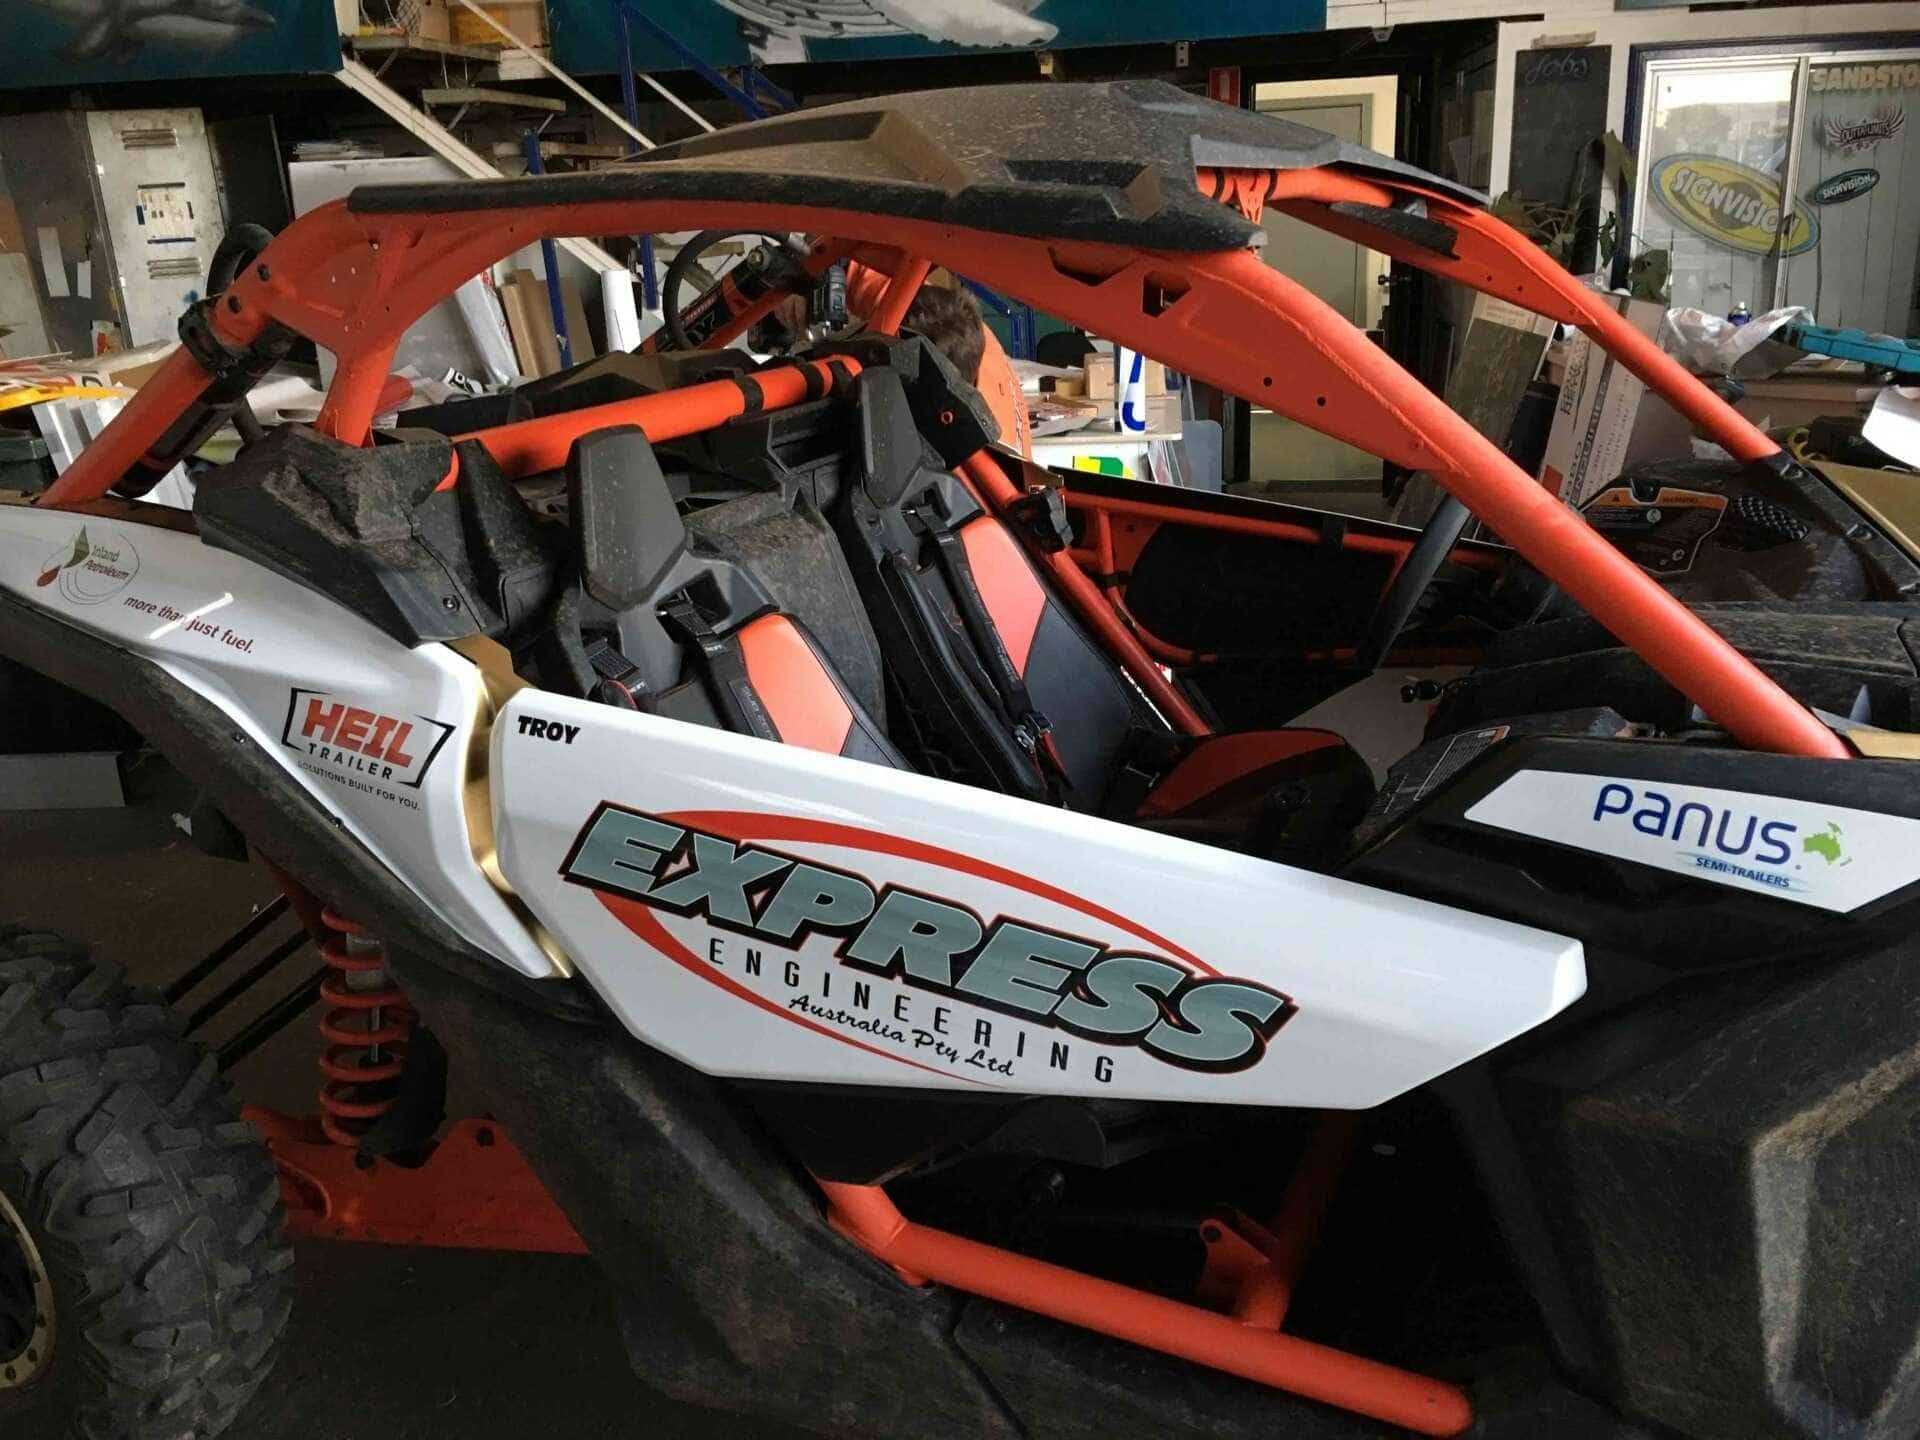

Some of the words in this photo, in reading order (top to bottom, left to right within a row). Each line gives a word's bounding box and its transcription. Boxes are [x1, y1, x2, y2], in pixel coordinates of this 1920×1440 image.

[1822, 173, 1873, 199] SIGNVISION
[84, 559, 130, 581] Petroleum
[90, 545, 121, 562] Inland
[123, 597, 157, 614] more
[186, 616, 219, 638] just
[220, 629, 253, 654] fuel.
[301, 698, 414, 768] HEIL
[517, 714, 582, 745] TROY
[308, 742, 393, 780] TRAILER
[349, 778, 374, 794] BUILT
[376, 788, 396, 802] FOR
[399, 796, 421, 811] YOU.
[1695, 856, 1790, 888] SEMI-TRAILERS
[560, 802, 1298, 1074] EXPRESS
[709, 937, 1115, 1084] ENGINEERING
[788, 994, 906, 1043] Australia
[911, 1028, 961, 1064] Pty
[965, 1049, 1016, 1077] Ltd
